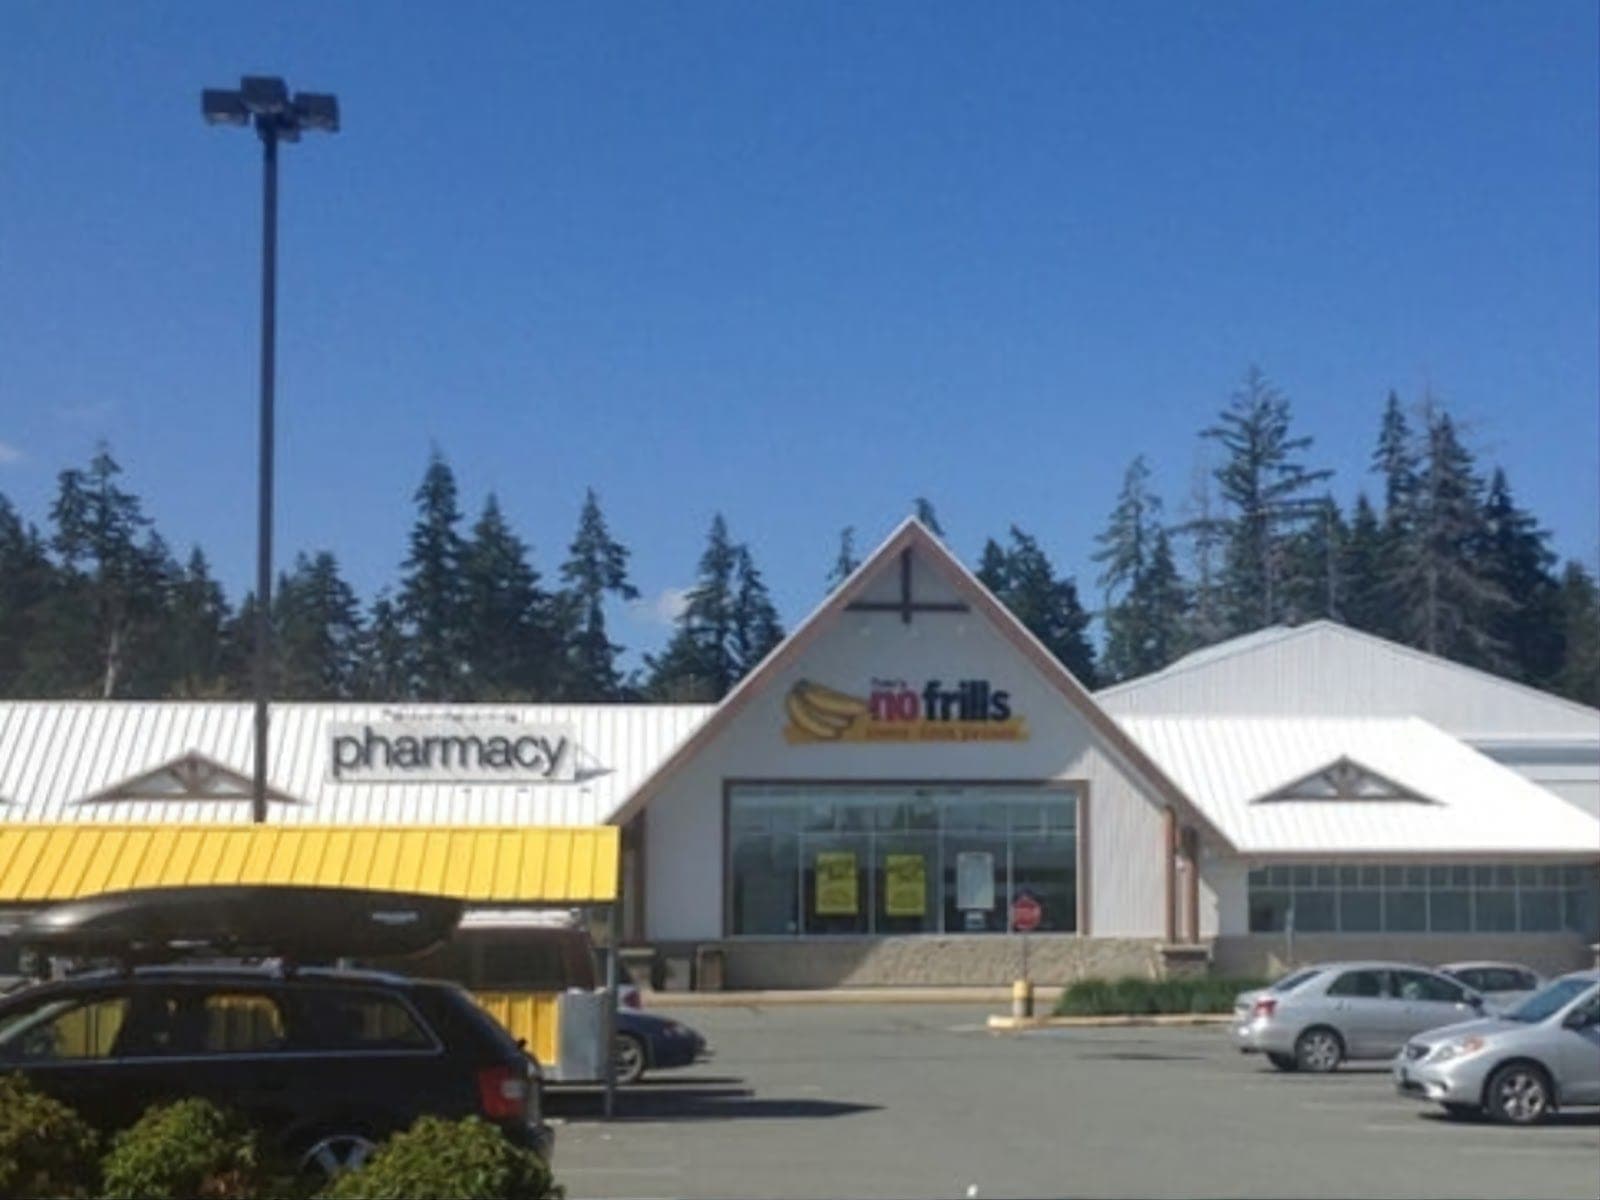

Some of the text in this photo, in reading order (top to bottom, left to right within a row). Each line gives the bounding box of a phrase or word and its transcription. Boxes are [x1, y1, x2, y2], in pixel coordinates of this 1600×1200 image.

[869, 680, 1012, 722] no frills
[332, 725, 567, 779] pharmacy
